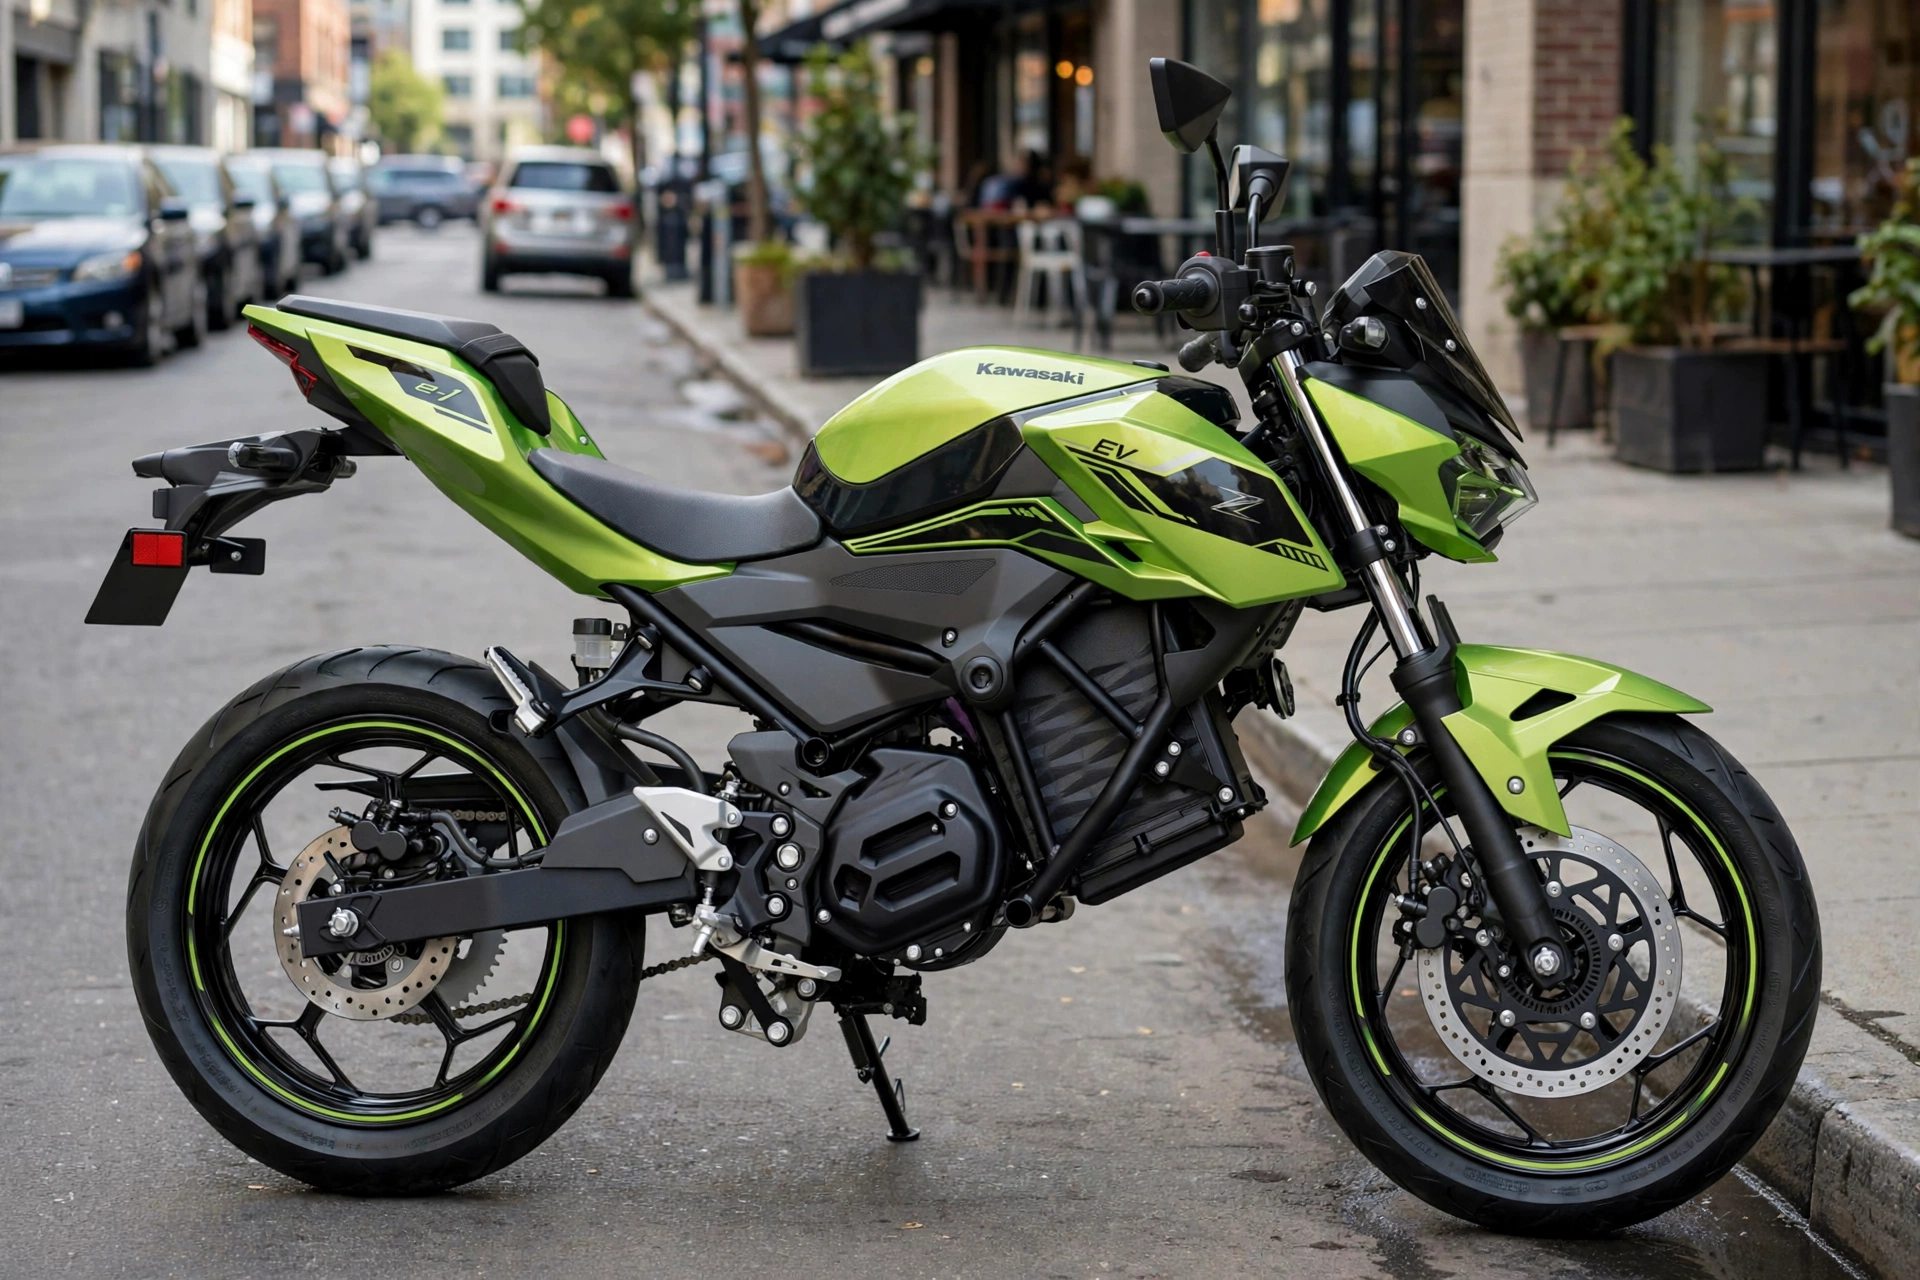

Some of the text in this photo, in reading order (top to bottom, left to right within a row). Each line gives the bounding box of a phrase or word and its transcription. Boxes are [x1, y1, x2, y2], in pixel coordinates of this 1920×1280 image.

[976, 362, 1085, 385] Kawasaki
[414, 382, 463, 402] e-1
[1092, 438, 1139, 460] EV
